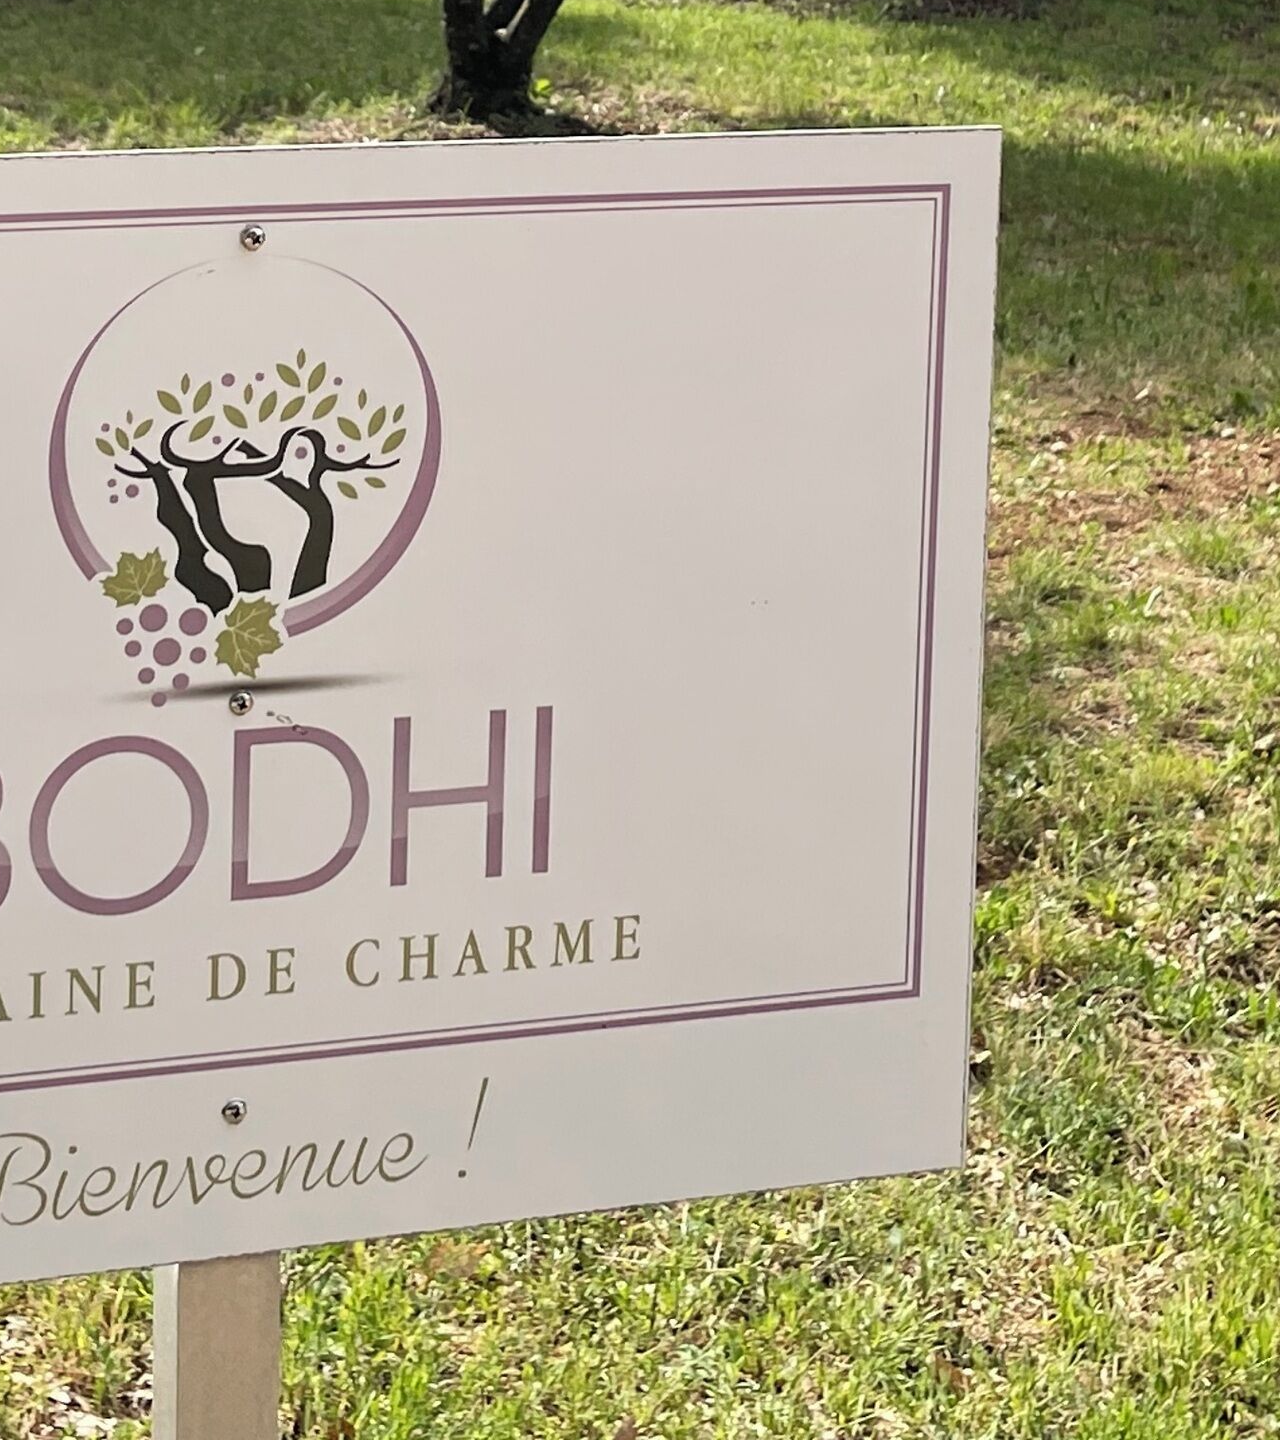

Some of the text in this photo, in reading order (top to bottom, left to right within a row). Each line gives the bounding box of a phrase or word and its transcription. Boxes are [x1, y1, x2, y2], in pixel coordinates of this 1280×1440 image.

[205, 947, 299, 1003] DE
[345, 913, 645, 989] CHARME
[456, 1076, 491, 1180] !
